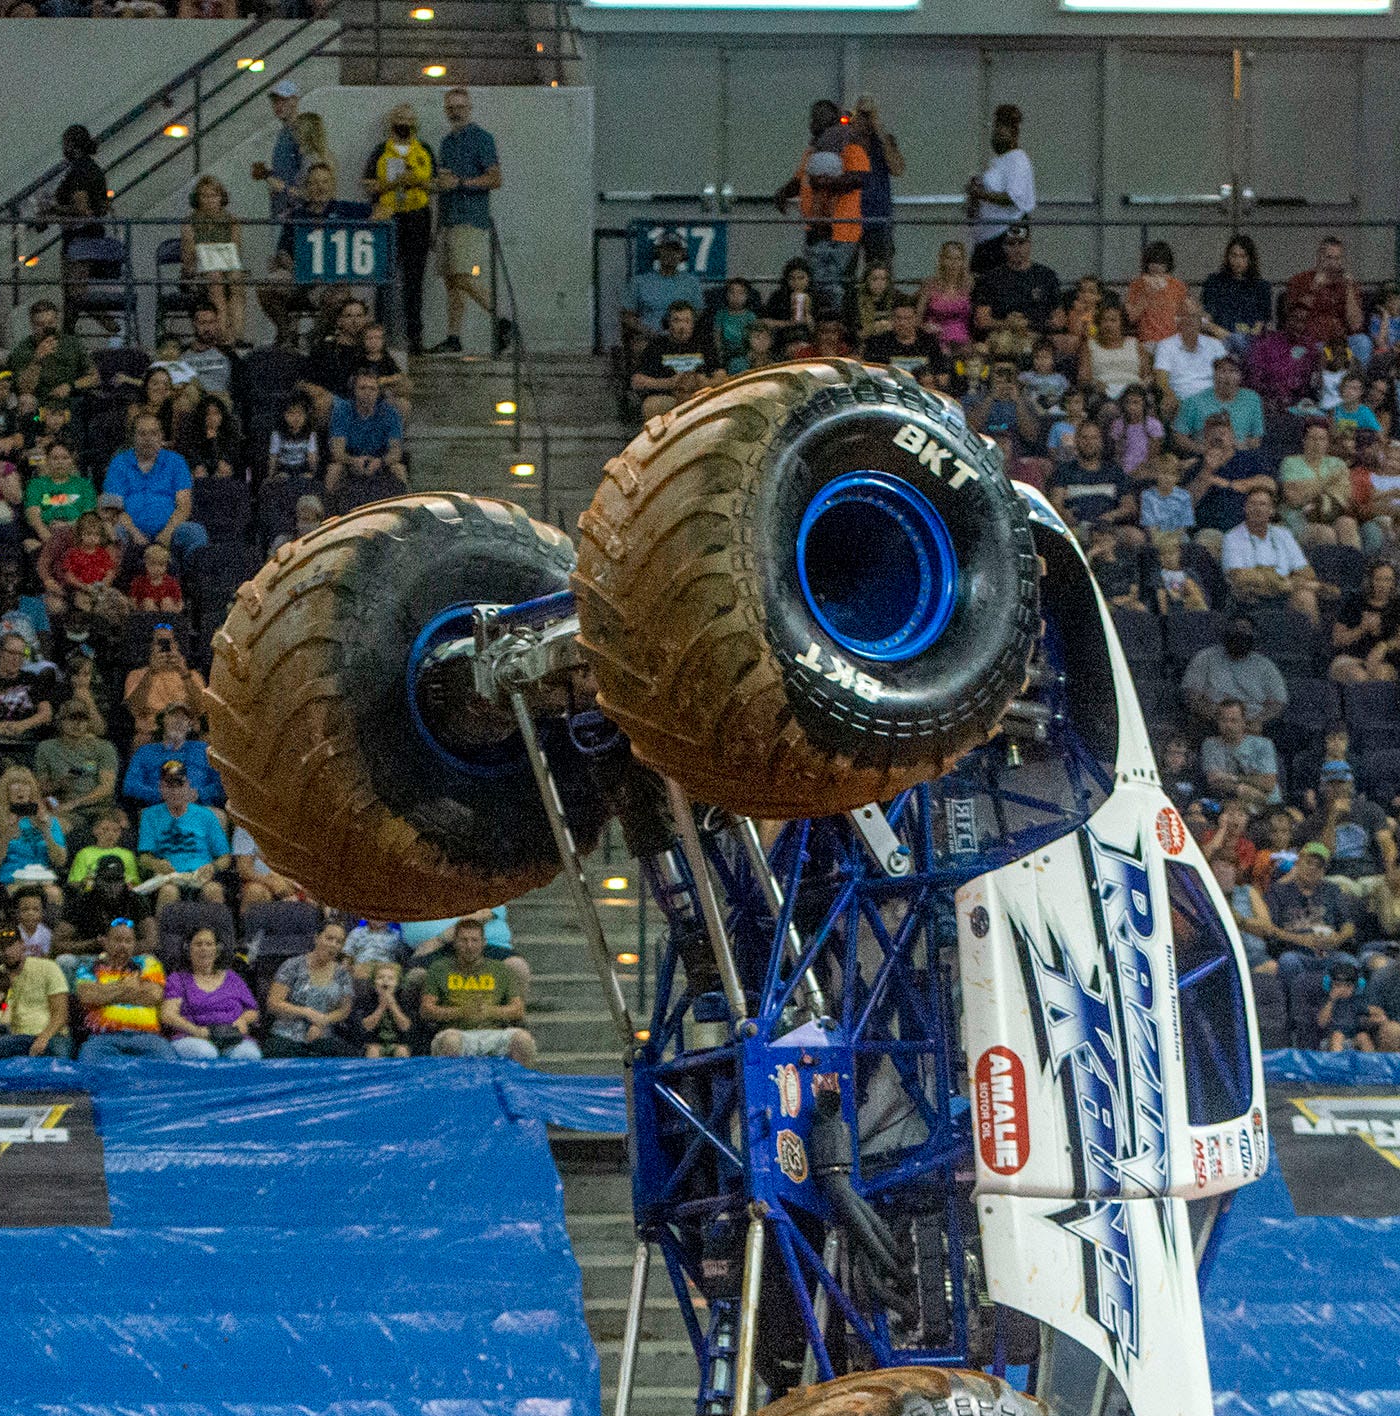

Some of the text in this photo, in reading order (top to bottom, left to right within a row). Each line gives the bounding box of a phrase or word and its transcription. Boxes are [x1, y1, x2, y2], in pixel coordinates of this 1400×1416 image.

[307, 229, 376, 275] 116
[891, 423, 981, 492] BKT
[795, 642, 888, 705] BKT
[979, 1081, 992, 1141] MOTOR OIL
[988, 1053, 1019, 1168] AMALIE
[1193, 1138, 1207, 1189] MSD
